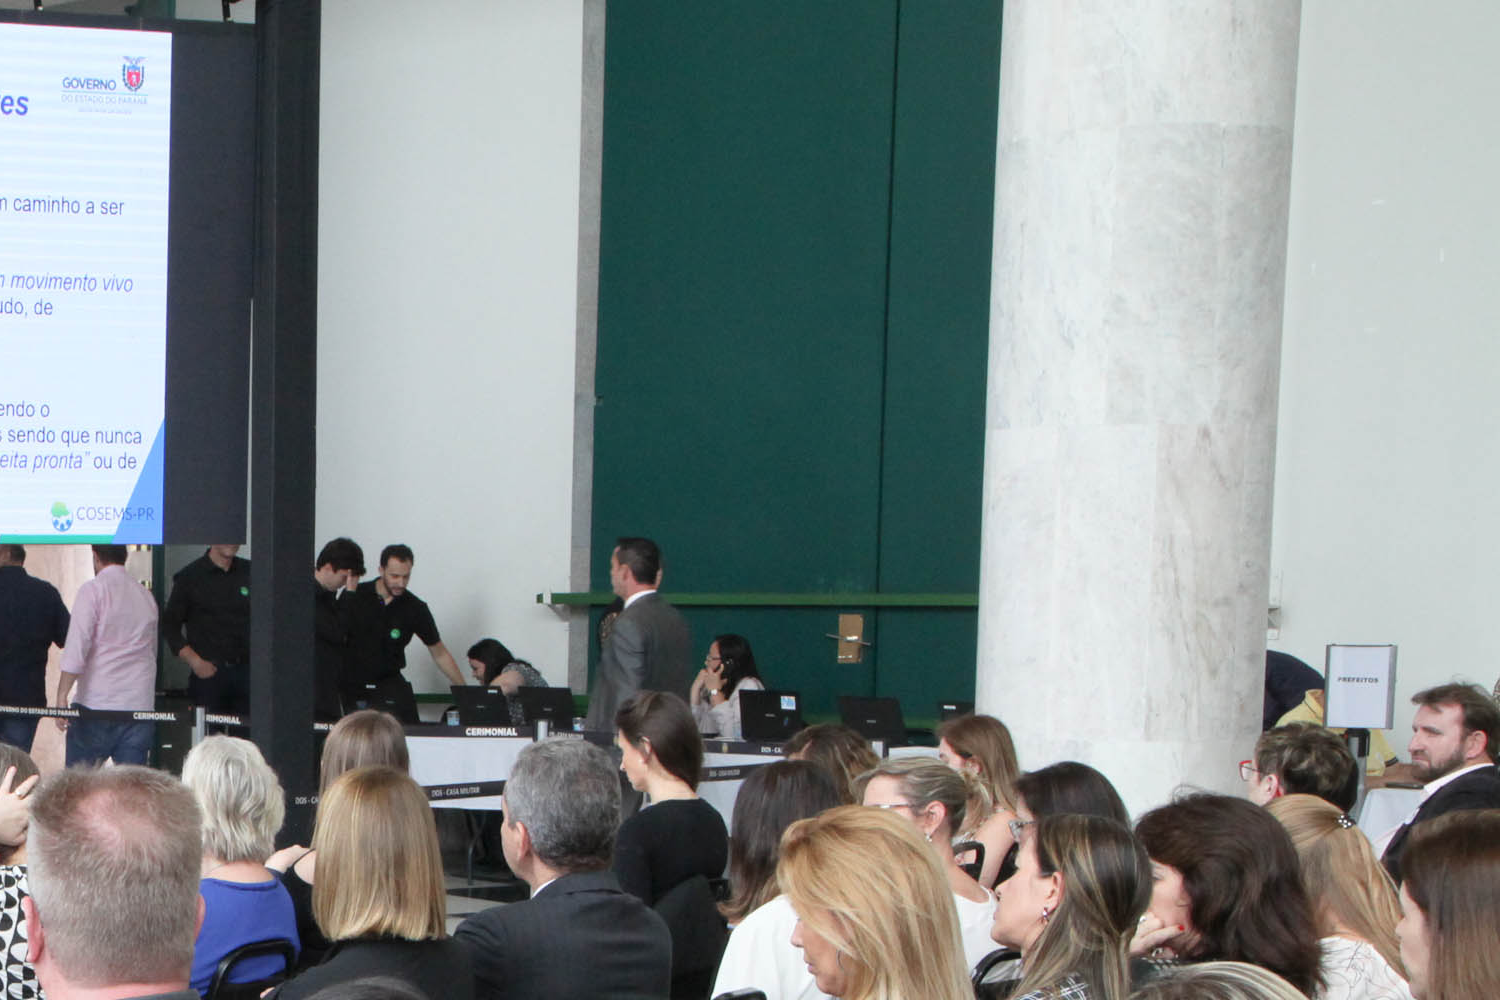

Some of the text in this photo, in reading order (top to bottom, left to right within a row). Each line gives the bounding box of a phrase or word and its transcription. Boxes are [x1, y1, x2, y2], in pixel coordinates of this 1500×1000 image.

[62, 77, 116, 91] GOVERNO
[13, 196, 80, 214] caminho
[85, 200, 94, 214] a
[99, 201, 124, 215] ser
[10, 274, 97, 291] movimento
[102, 275, 133, 292] vivo
[33, 298, 53, 315] de
[39, 404, 50, 417] o
[7, 427, 55, 443] sendo
[60, 430, 90, 448] que
[95, 430, 142, 444] nunca
[93, 456, 112, 469] ou
[117, 452, 137, 469] de
[76, 506, 154, 521] COSEMS-PR
[133, 712, 176, 721] CERIMONIAL
[206, 714, 241, 725] RIMONIAL
[465, 727, 518, 736] CERIMONIAL
